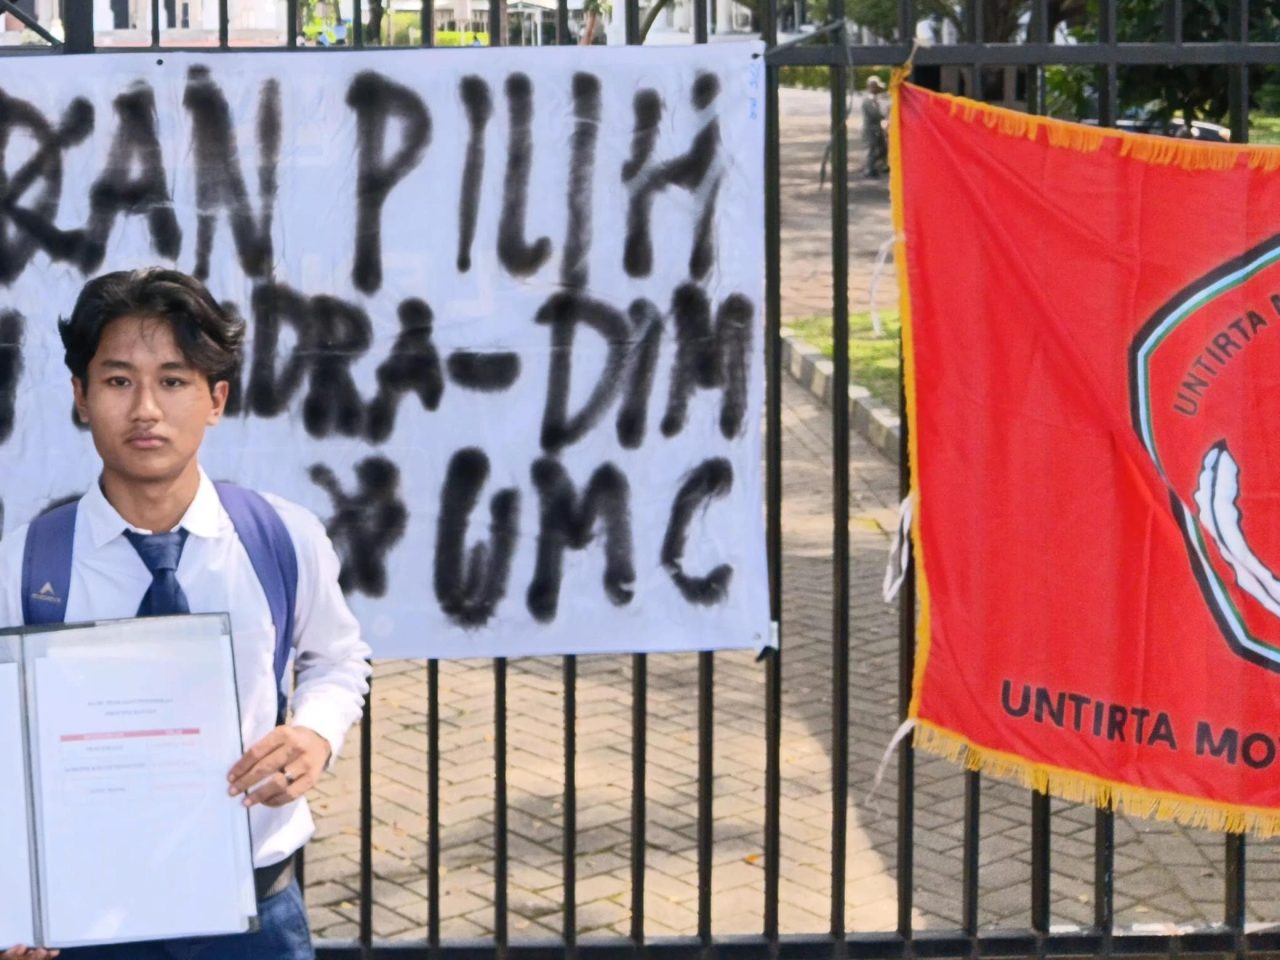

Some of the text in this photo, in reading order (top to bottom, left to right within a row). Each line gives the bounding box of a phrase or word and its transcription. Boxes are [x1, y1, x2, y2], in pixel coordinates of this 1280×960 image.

[346, 70, 722, 295] PILIH
[1173, 309, 1268, 416] UNTIRTA
[1001, 679, 1280, 769] UNTIRTA MO
